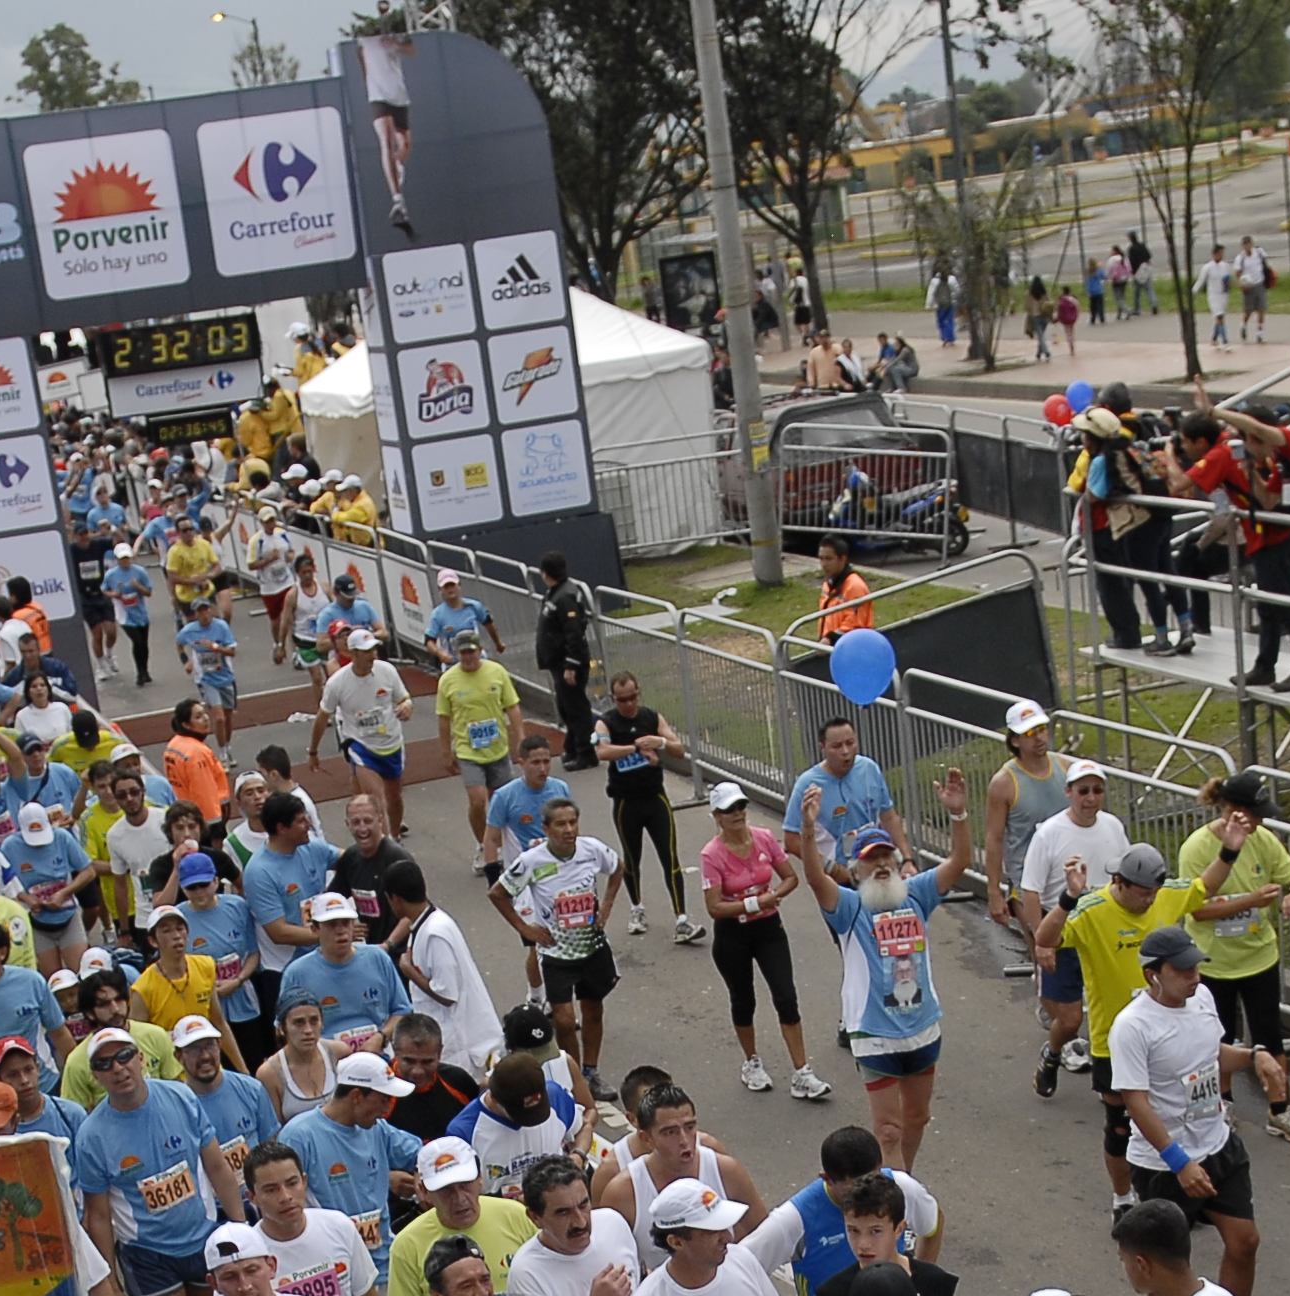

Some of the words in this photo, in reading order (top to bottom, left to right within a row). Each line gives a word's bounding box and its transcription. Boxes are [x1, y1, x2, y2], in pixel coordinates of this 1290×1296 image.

[53, 216, 169, 254] Porvenir
[230, 212, 334, 240] Carrefour
[63, 257, 98, 276] Sólo
[100, 253, 133, 276] hay
[137, 249, 168, 265] uno
[491, 279, 552, 301] adidas
[503, 358, 563, 391] Gatorade
[136, 379, 202, 397] Carrefour
[422, 391, 471, 421] Doria
[518, 472, 578, 489] acueducto
[470, 726, 495, 740] 9016
[557, 896, 593, 914] 11212
[877, 918, 923, 939] 11271
[1189, 1073, 1220, 1102] 4416
[154, 1168, 188, 1184] Porvenir
[144, 1177, 194, 1209] 36181
[292, 1262, 329, 1282] Porvenir
